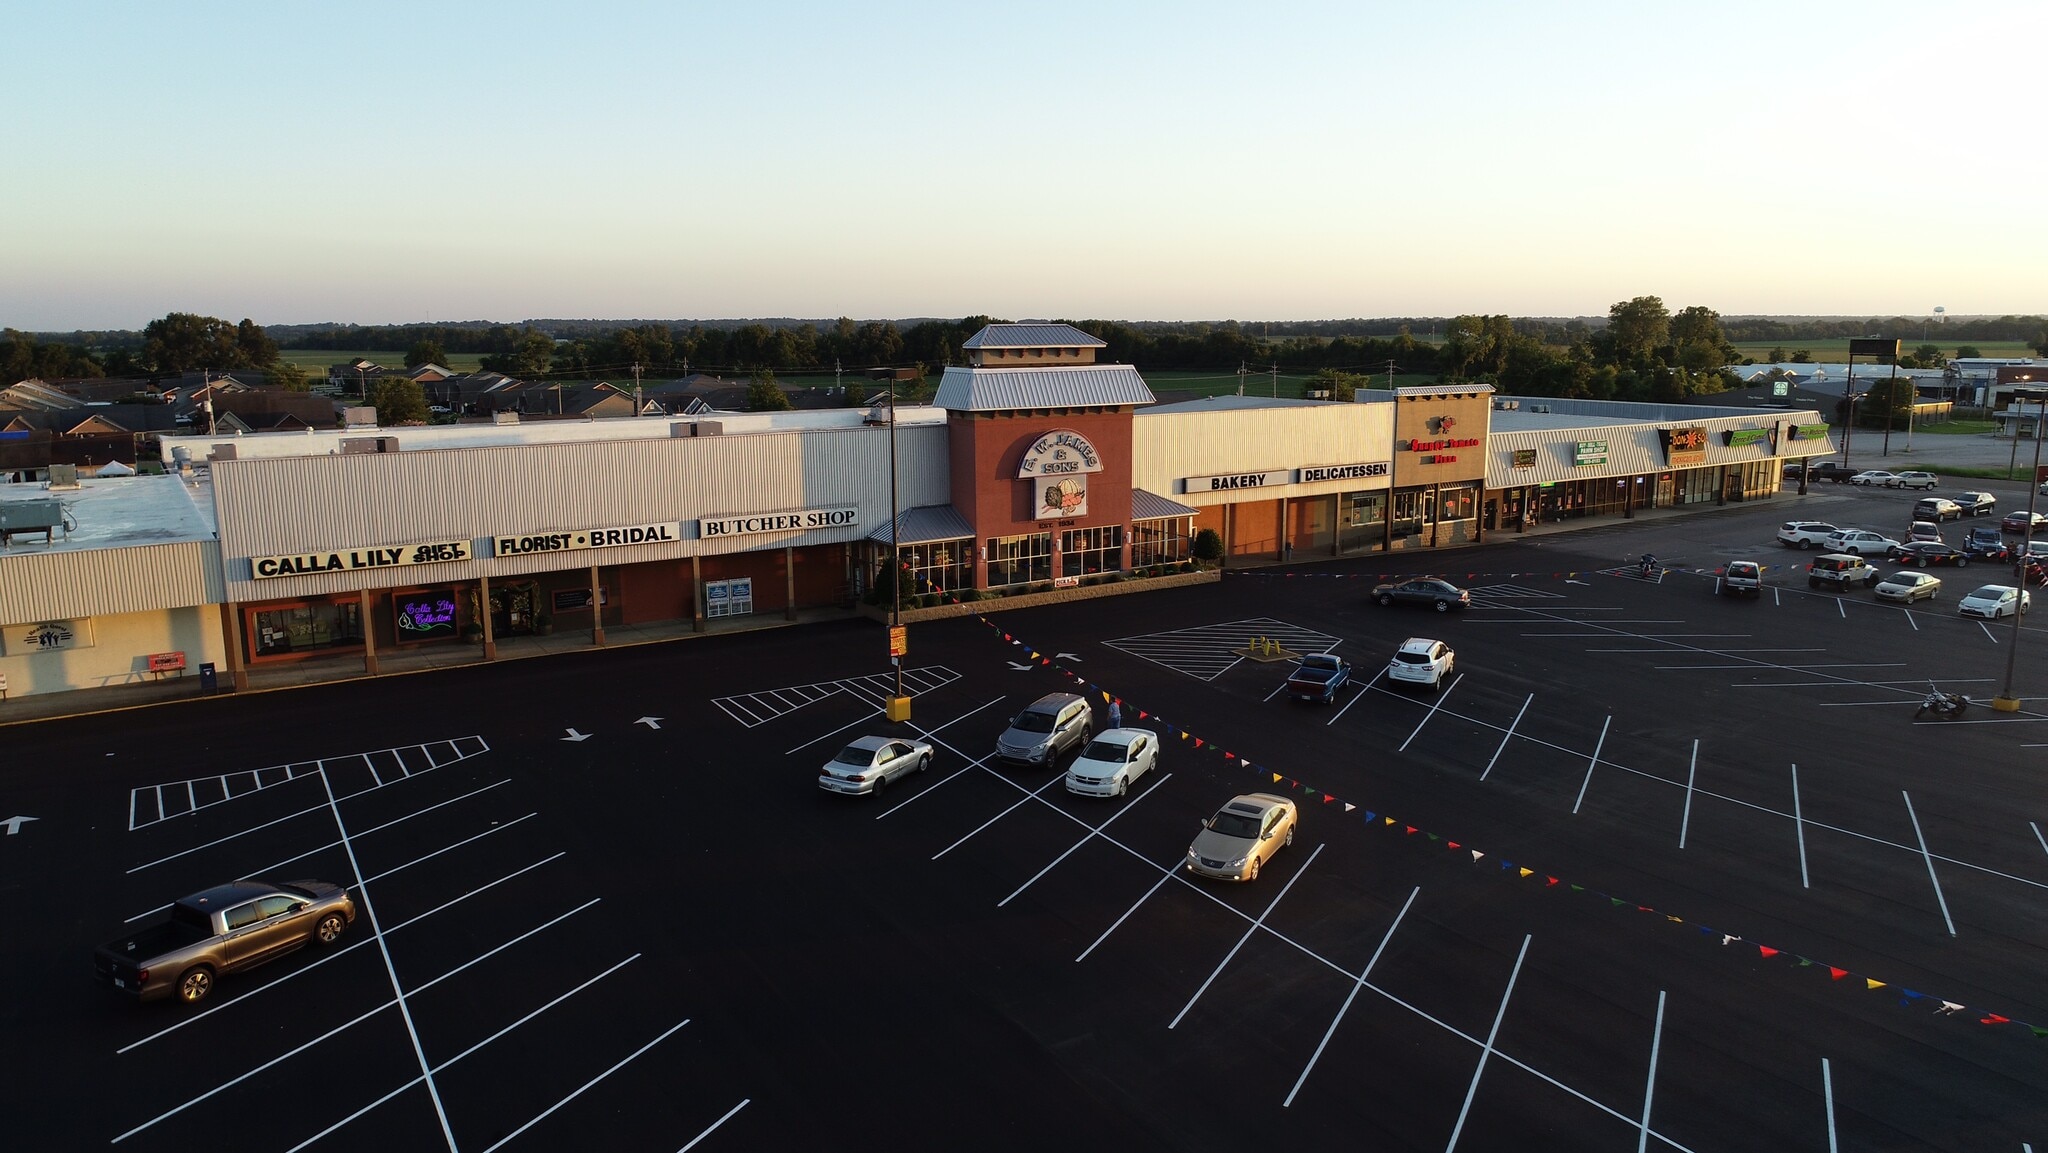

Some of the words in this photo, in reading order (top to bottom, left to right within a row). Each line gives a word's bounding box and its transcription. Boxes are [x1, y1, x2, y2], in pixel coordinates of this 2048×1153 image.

[1024, 457, 1038, 472] E.
[1035, 438, 1054, 454] W.
[1056, 434, 1098, 467] JAMES
[1055, 448, 1067, 460] &
[1043, 461, 1079, 474] SONS
[1211, 474, 1266, 490] BAKERY
[1305, 464, 1387, 481] DELICATESSEN
[706, 514, 802, 536] BUTCHER
[807, 510, 855, 527] SHOP
[500, 534, 571, 554] FLORIST
[590, 525, 672, 546] BRIDAL
[416, 542, 460, 555] GIFT
[258, 554, 344, 576] CALLA
[351, 547, 404, 569] LILY
[412, 550, 466, 563] SHOP
[405, 602, 431, 614] Calla
[436, 600, 454, 615] Lily
[414, 613, 451, 625] Collection
